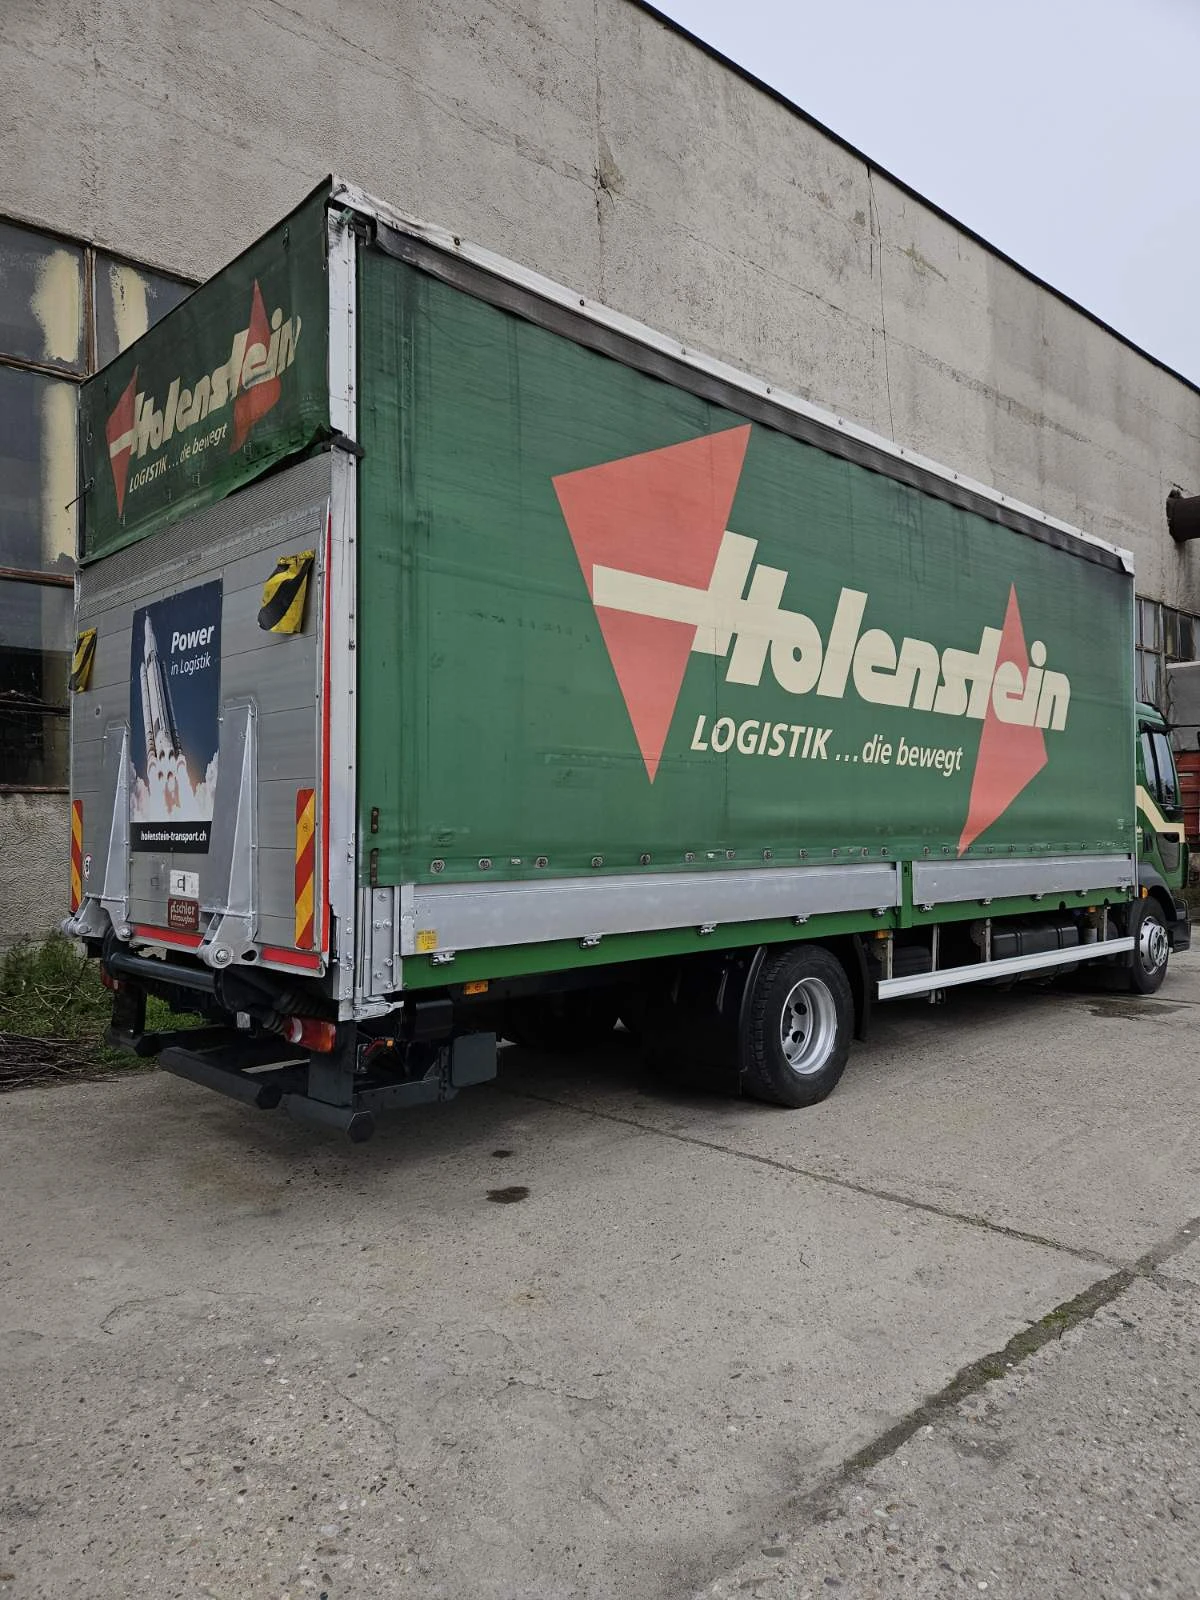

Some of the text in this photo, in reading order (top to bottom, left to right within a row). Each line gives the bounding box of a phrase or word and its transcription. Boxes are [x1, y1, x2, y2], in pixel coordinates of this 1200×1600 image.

[110, 308, 302, 459] Holenstein
[129, 455, 168, 493] LOGISTIK
[191, 423, 228, 454] bewegt
[171, 626, 215, 654] Power
[592, 530, 1071, 731] Holenstein
[171, 652, 211, 676] in Logistik
[690, 715, 833, 760] LOGISTIK
[896, 737, 963, 777] bewegt
[141, 830, 207, 843] holenstein-transport.ch
